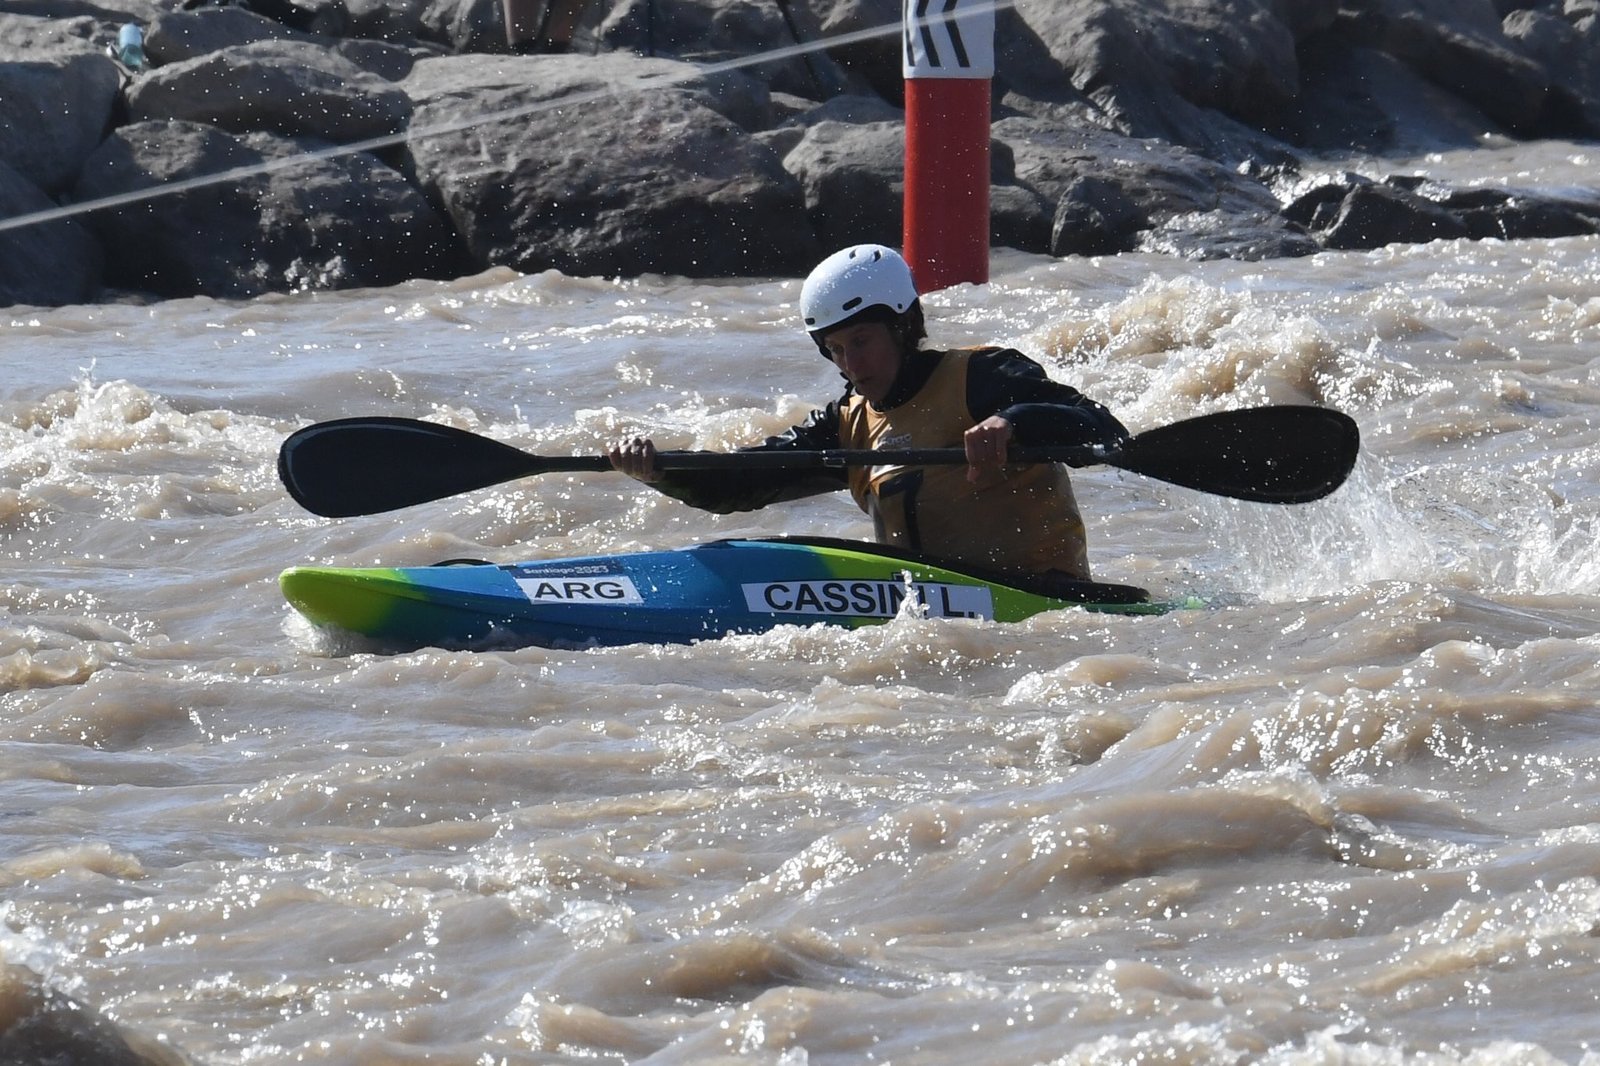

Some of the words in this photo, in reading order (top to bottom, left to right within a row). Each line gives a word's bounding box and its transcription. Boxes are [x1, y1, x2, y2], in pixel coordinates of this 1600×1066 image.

[522, 566, 574, 575] Santiago
[574, 565, 610, 574] 2023
[534, 581, 625, 600] ARG
[940, 586, 976, 619] L.
